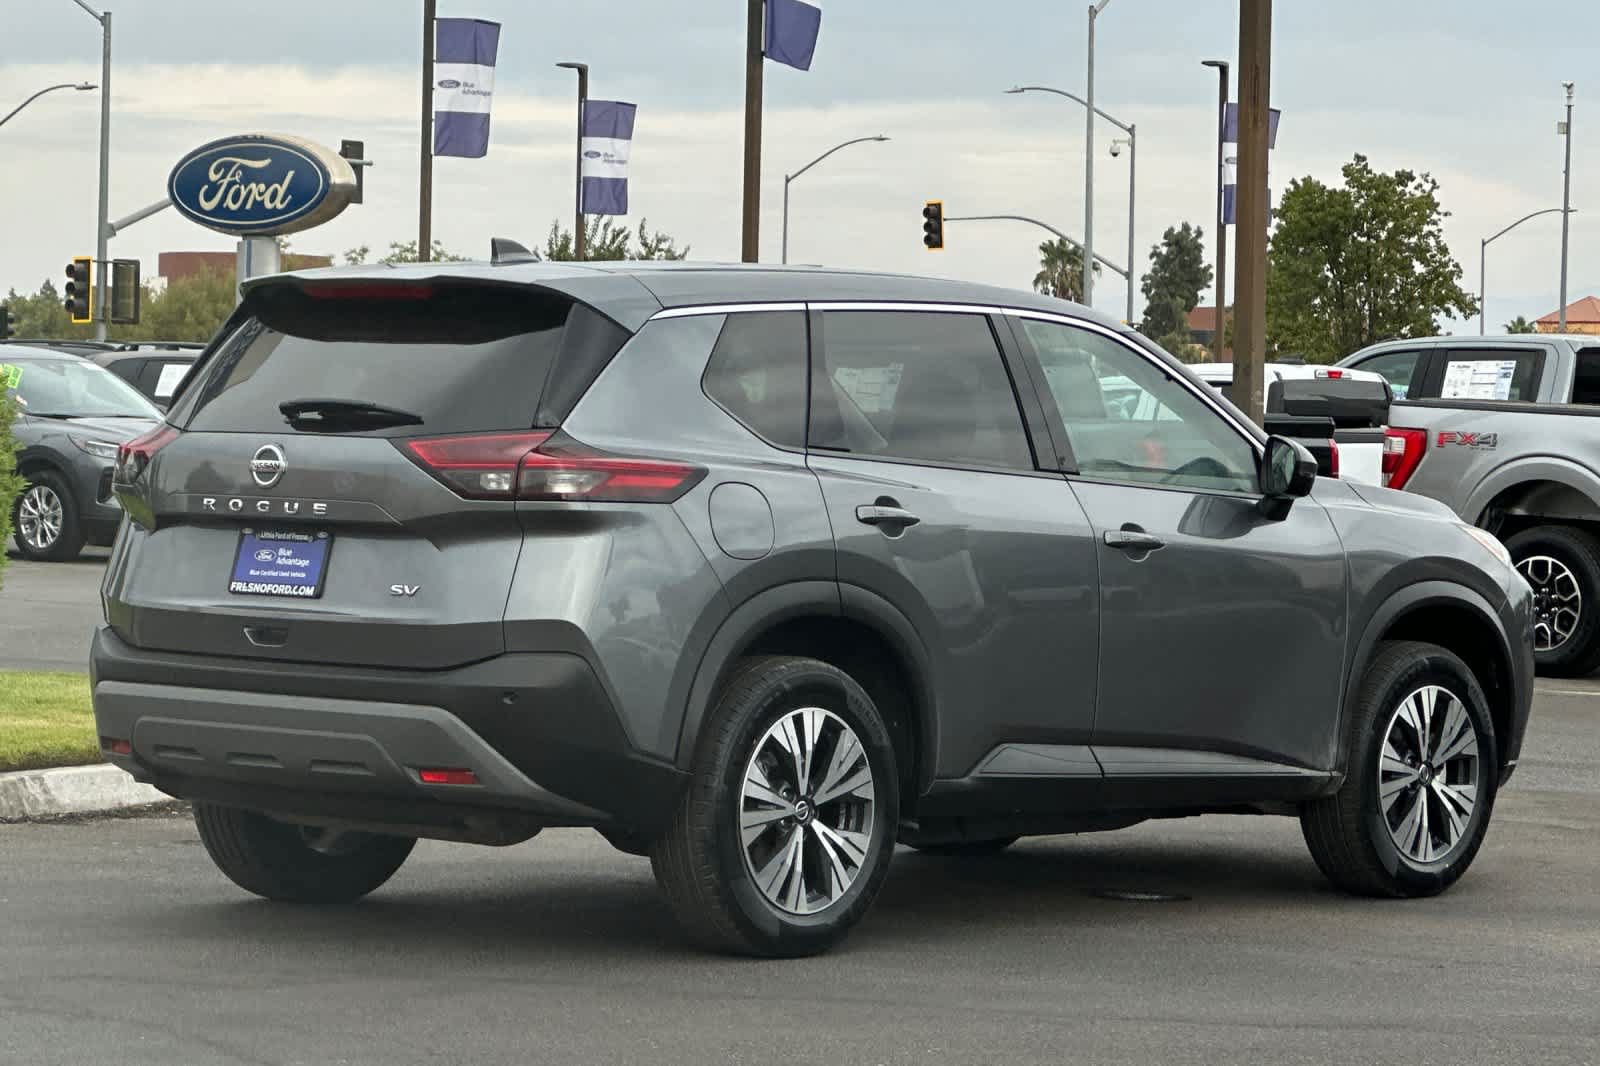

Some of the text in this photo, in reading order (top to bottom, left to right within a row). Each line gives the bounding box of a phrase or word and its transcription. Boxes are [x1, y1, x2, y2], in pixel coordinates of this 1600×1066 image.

[198, 156, 296, 212] Ford
[1437, 431, 1498, 447] FX4
[252, 461, 281, 471] NISSAN
[203, 498, 328, 514] ROGUE
[278, 547, 293, 556] Blue
[275, 556, 310, 568] Advantage
[230, 581, 315, 596] FRESNOFORD.COM
[389, 584, 420, 596] SV
